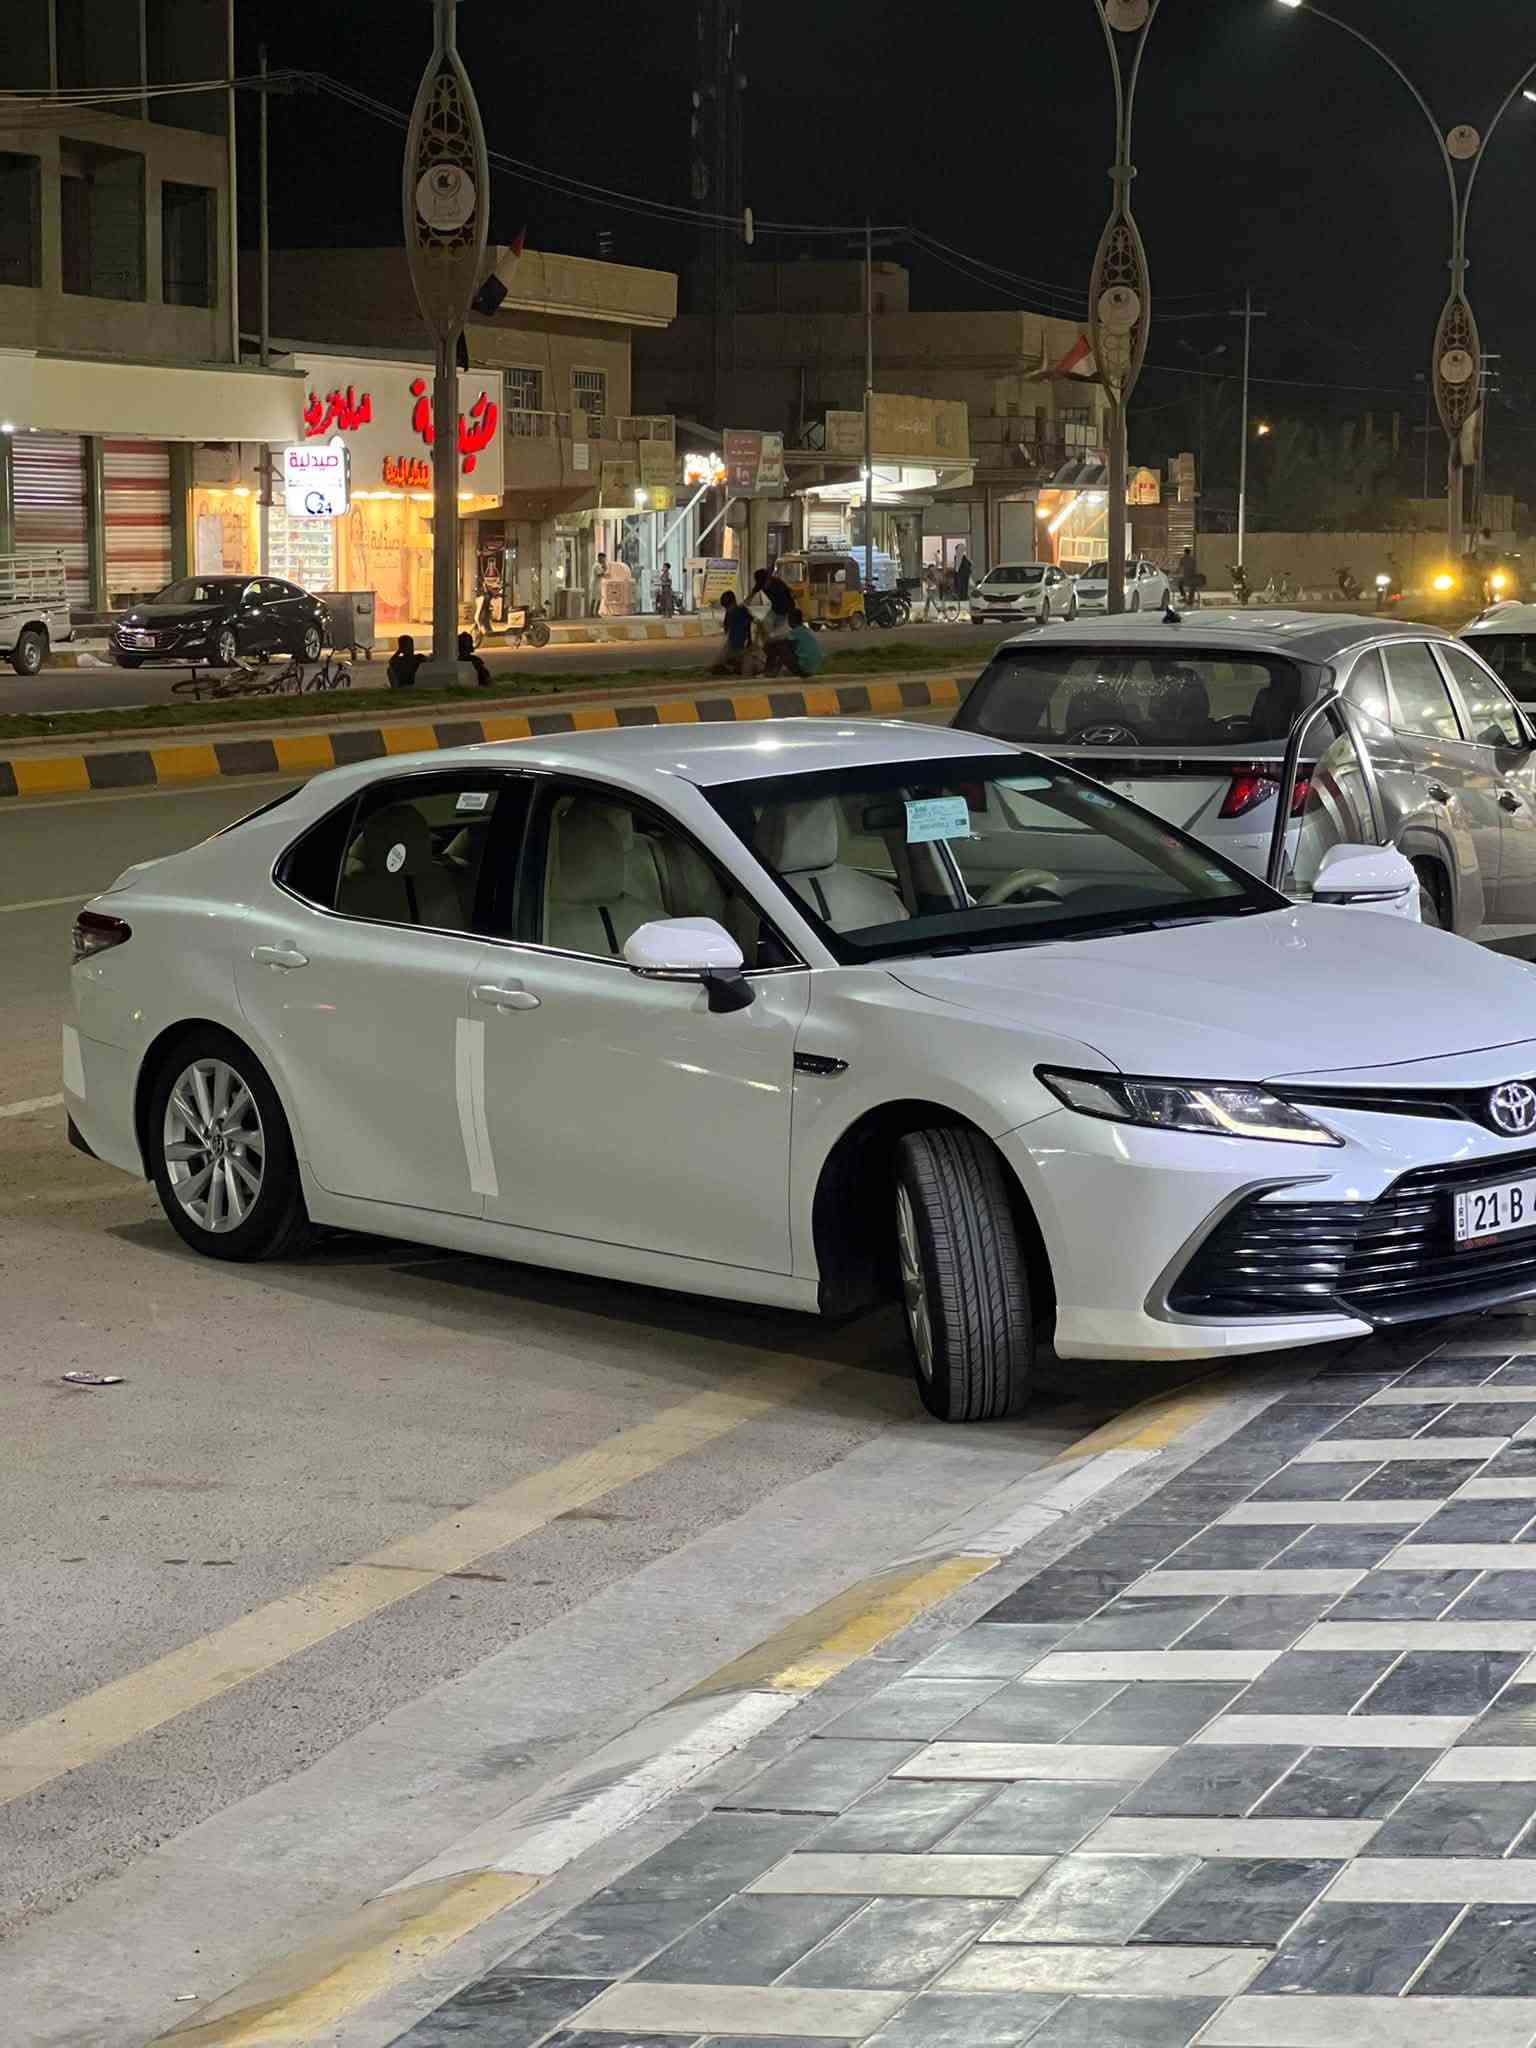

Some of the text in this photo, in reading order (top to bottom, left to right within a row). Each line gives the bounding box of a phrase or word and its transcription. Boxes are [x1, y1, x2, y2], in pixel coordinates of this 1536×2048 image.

[289, 451, 339, 471] صيدلية
[316, 502, 333, 514] 24
[1474, 1187, 1523, 1231] 21 B
